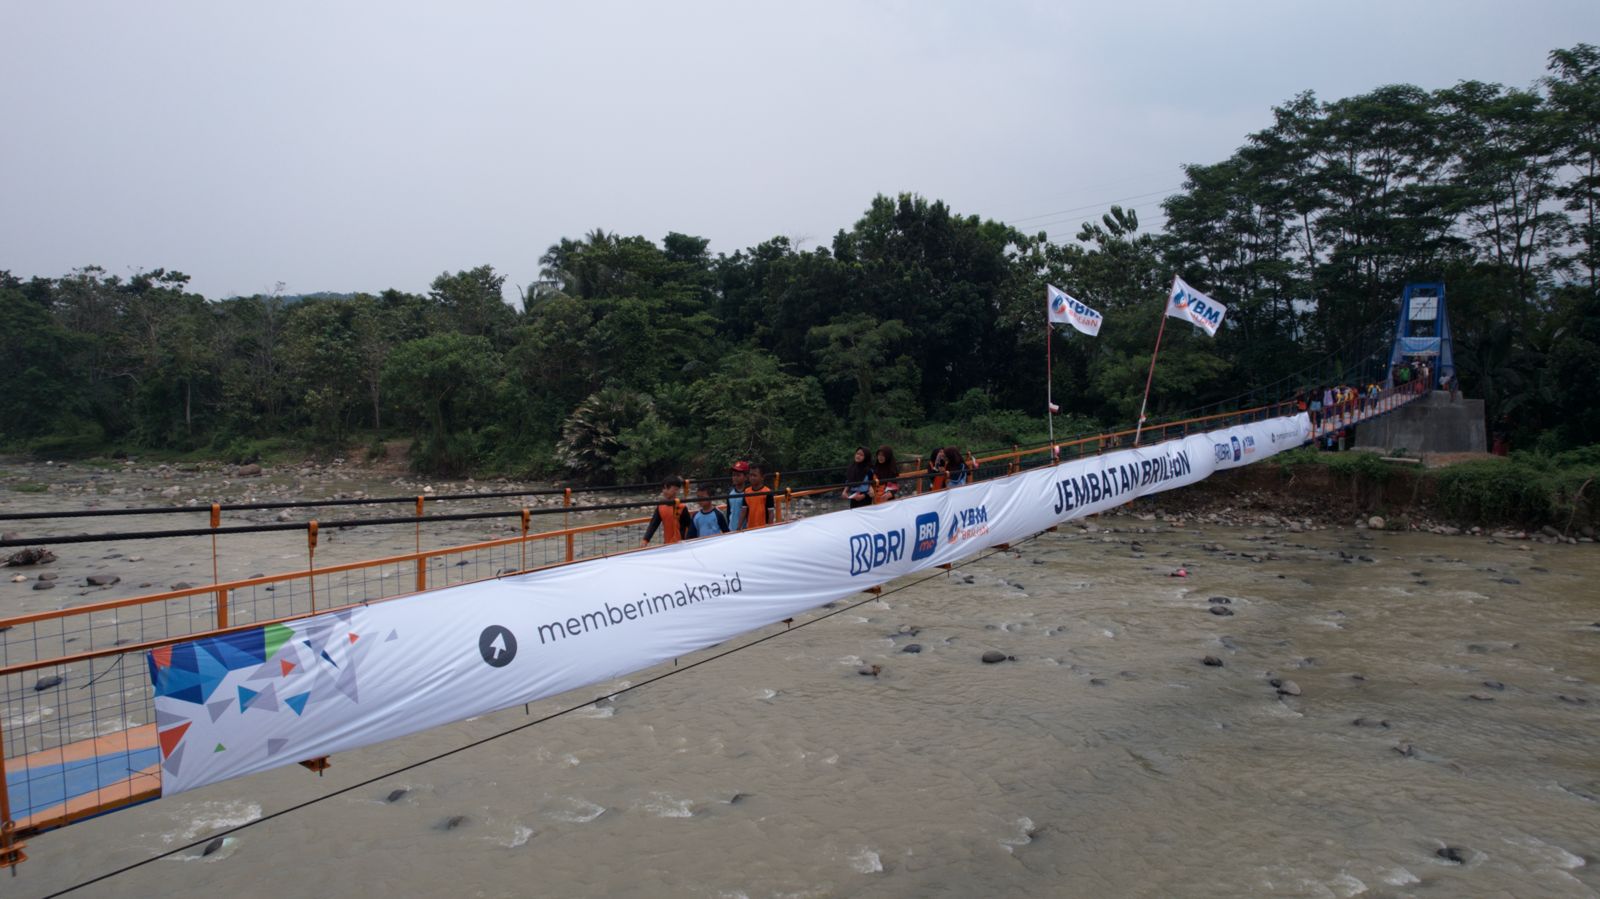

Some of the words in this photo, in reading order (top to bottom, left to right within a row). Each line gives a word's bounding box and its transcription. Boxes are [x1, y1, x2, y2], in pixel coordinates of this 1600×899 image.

[1187, 293, 1220, 323] YBM
[1054, 462, 1140, 514] JEMBATAN
[919, 521, 937, 541] BRI
[959, 505, 988, 528] YBM
[873, 528, 905, 568] BRI
[537, 572, 742, 645] memberimakna.id
